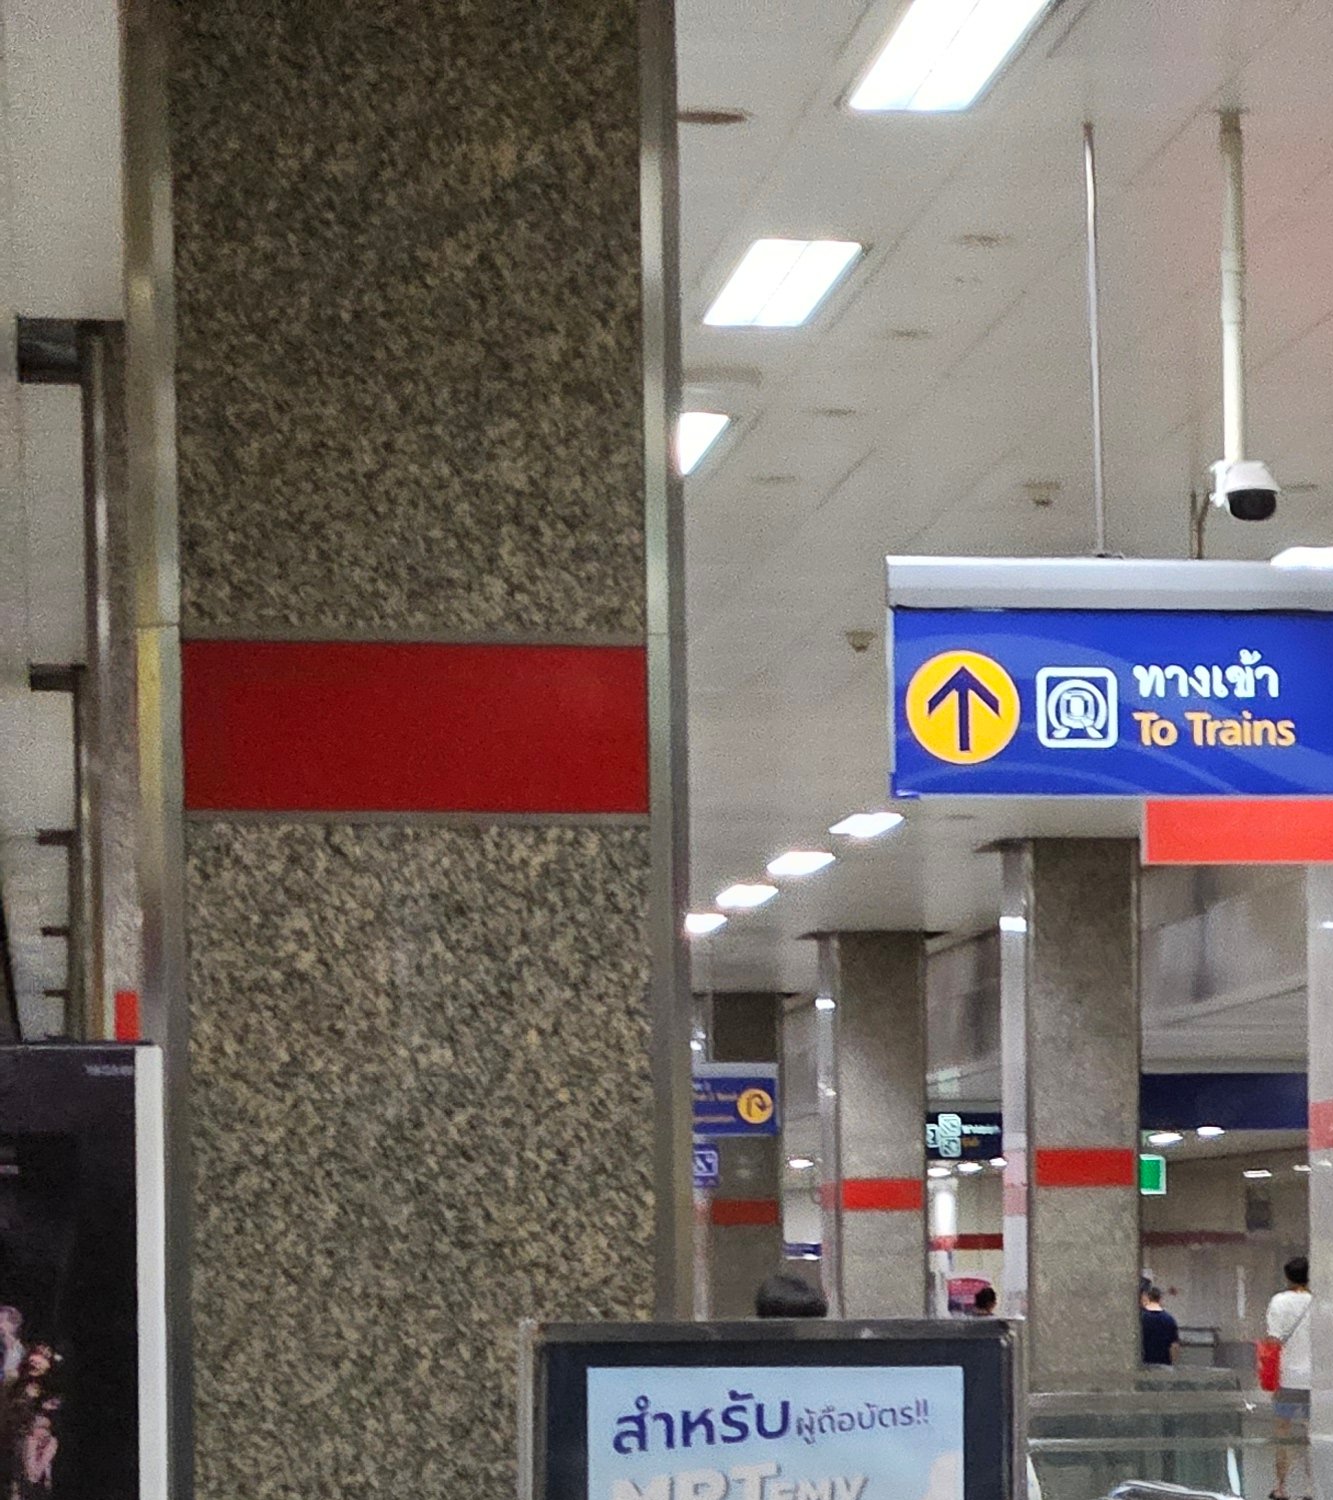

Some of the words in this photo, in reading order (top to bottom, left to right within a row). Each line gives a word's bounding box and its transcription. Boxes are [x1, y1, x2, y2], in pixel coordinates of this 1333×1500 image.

[1132, 648, 1280, 700] ทางเข้า
[1133, 710, 1178, 747] To
[1183, 710, 1296, 748] Trains
[612, 1389, 790, 1455] สำหรับ
[796, 1398, 930, 1446] ผู้ถือบัตร!!
